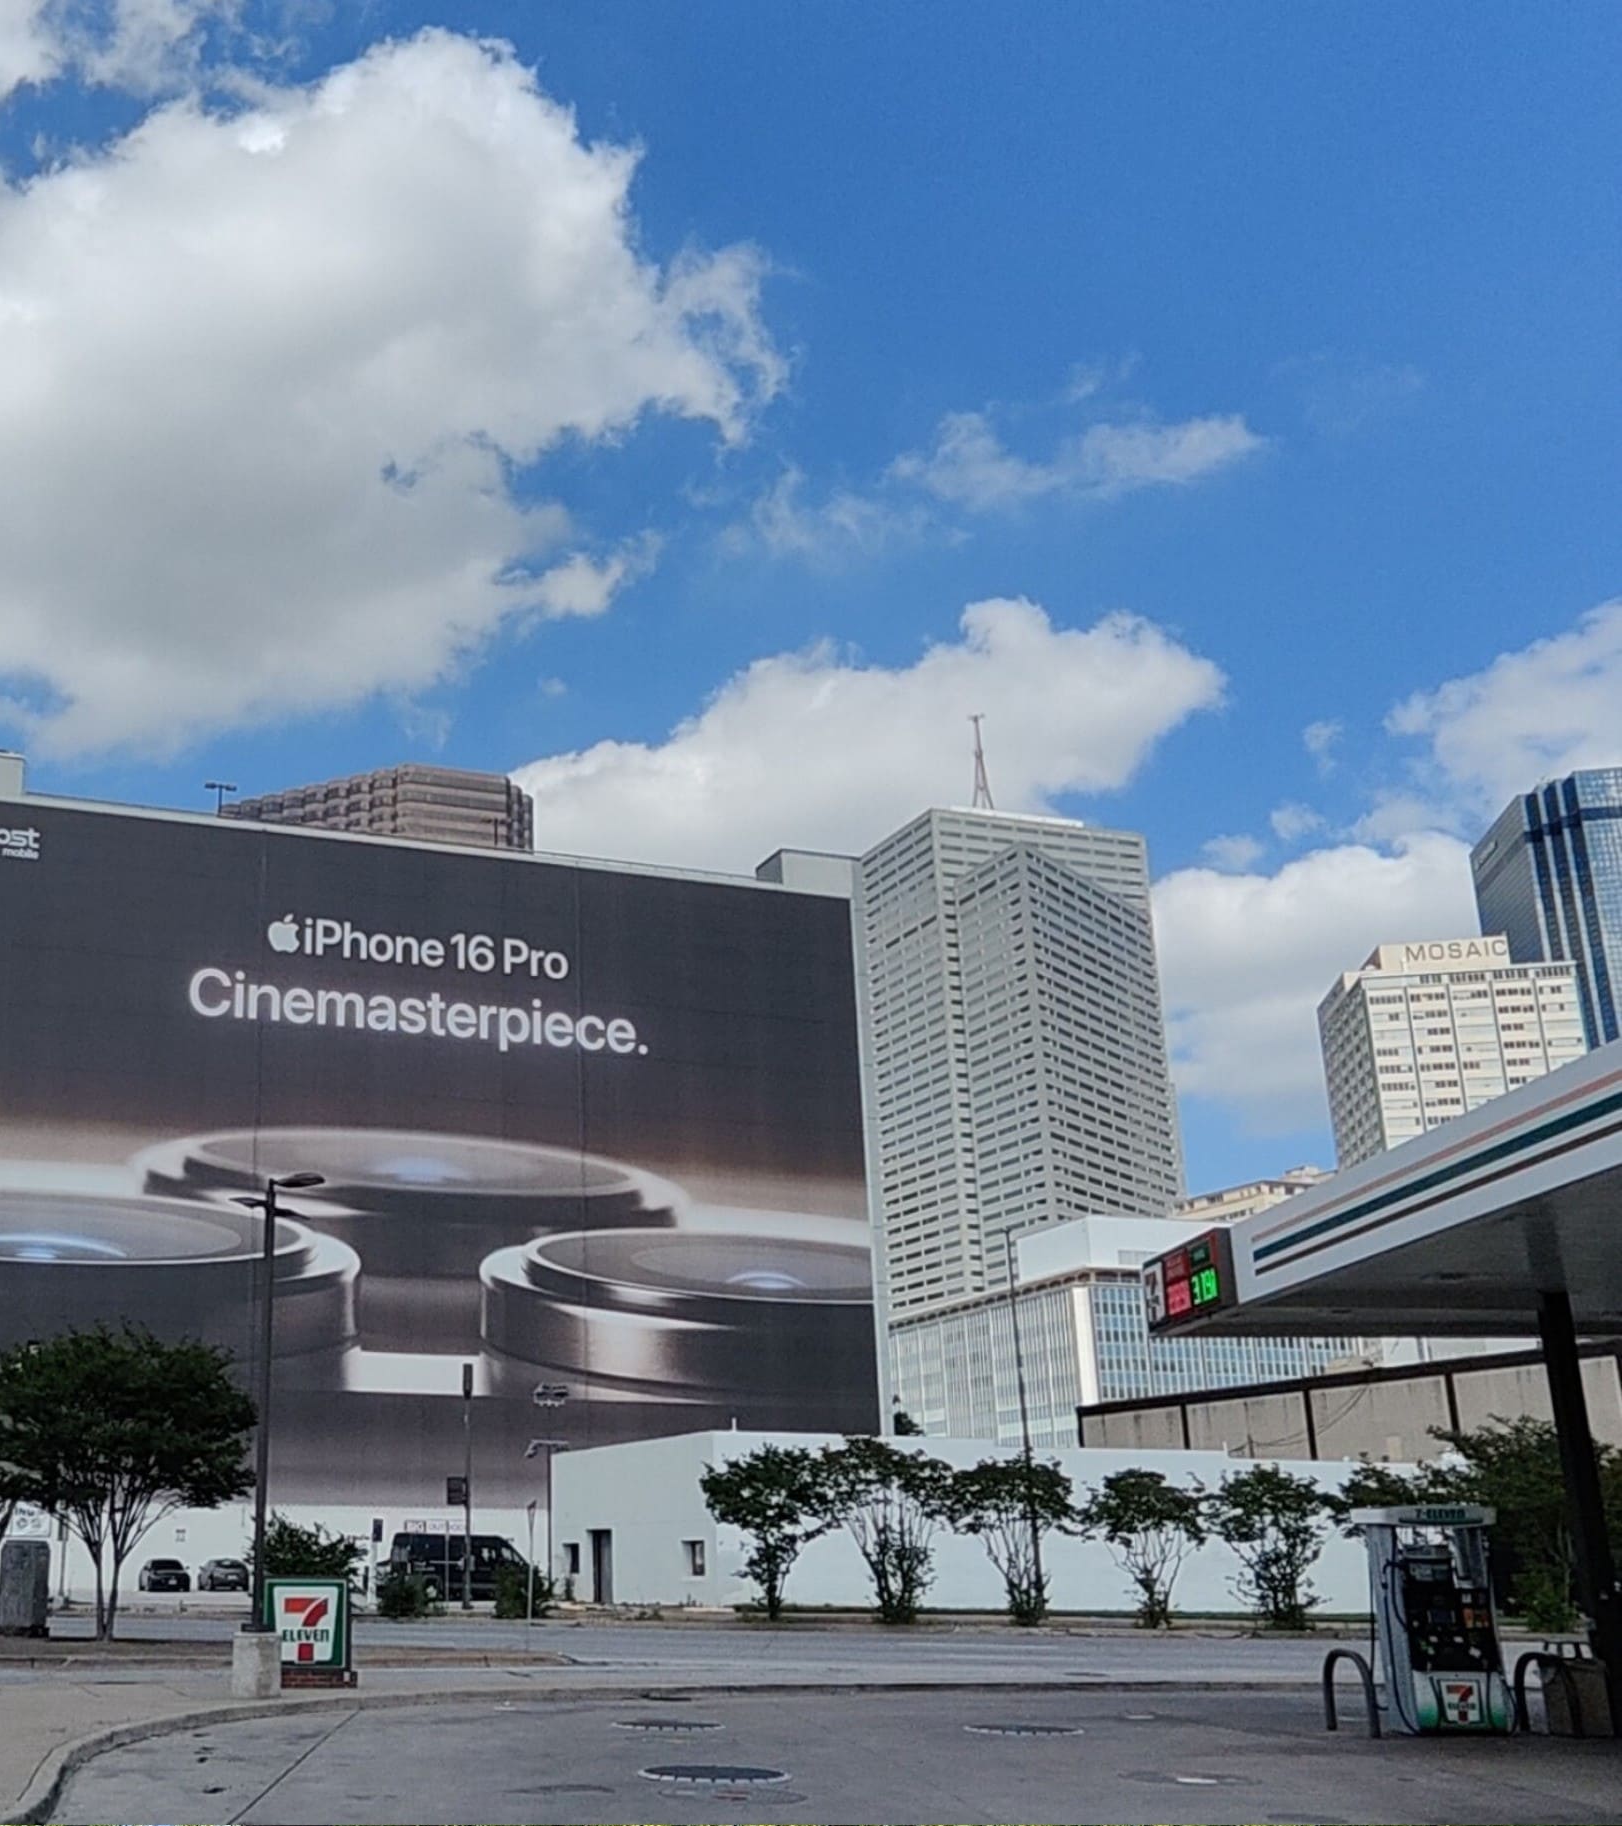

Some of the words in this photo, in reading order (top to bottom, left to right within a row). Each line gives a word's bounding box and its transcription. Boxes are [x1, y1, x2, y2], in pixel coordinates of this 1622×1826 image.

[1, 847, 40, 860] mobile
[302, 916, 445, 968] iPhone
[449, 933, 496, 973] 16
[503, 937, 570, 980] Pro
[1404, 939, 1508, 962] MOSAIC
[188, 967, 650, 1056] Cinemasterpiece.
